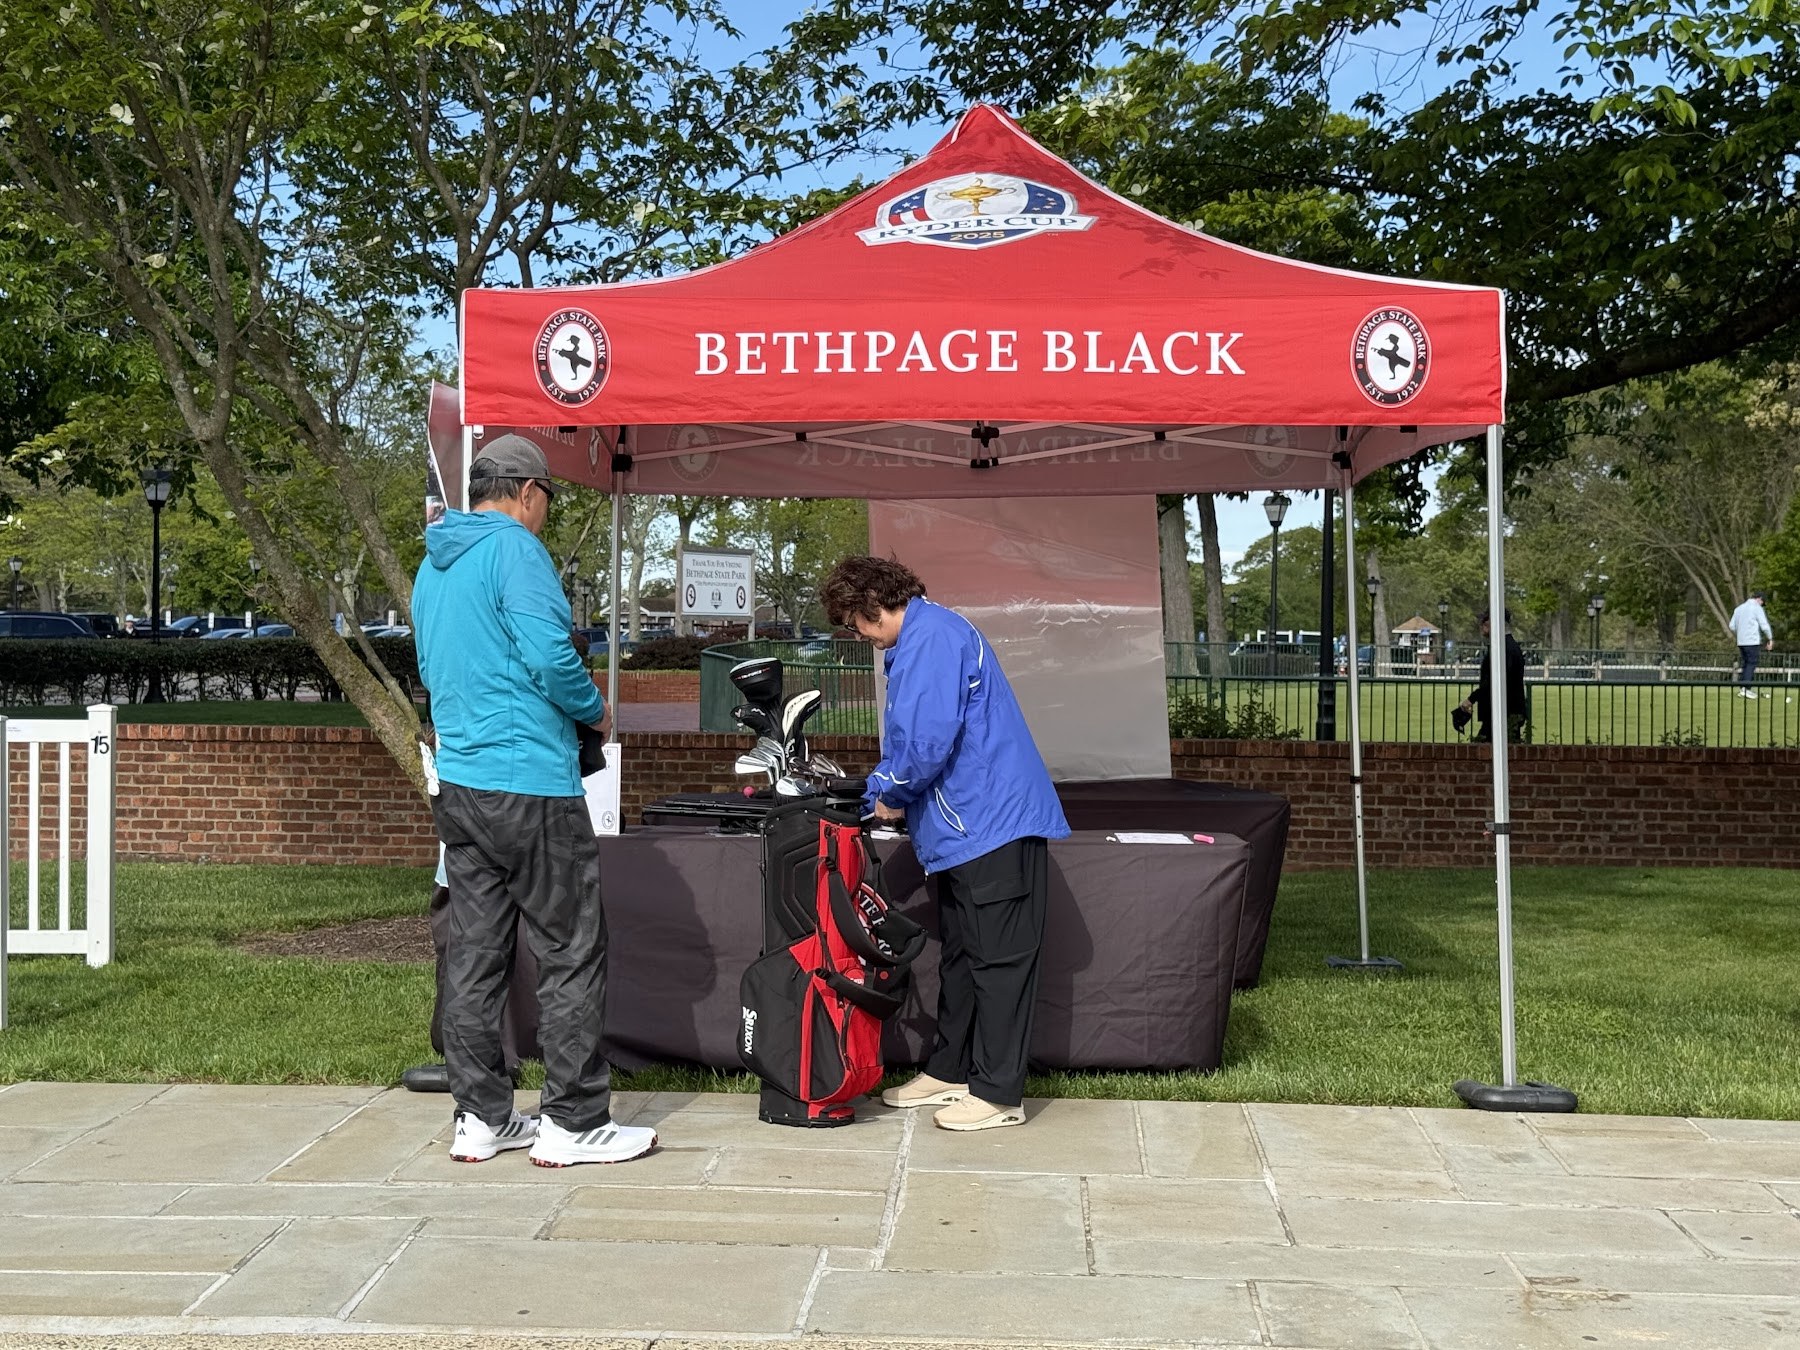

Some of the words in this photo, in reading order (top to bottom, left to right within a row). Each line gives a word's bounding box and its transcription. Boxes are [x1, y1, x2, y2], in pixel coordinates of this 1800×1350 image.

[879, 217, 1000, 238] RYDER
[1003, 216, 1078, 227] CUP
[950, 231, 1005, 241] 2025
[538, 313, 568, 361] BETHPAGE
[569, 312, 598, 333] STATE
[593, 332, 607, 360] PARK
[1355, 312, 1387, 359] BETHPAGE
[1389, 311, 1417, 333] STATE
[1413, 331, 1427, 360] PARK
[694, 329, 1019, 375] BETHPAGE
[1042, 330, 1246, 375] BLACK
[547, 382, 568, 402] EST.
[578, 381, 599, 401] 1932
[1364, 382, 1385, 402] EST.
[1397, 381, 1418, 401] 1932
[686, 568, 713, 579] BETHPAGE
[714, 570, 730, 579] STATE
[731, 570, 746, 580] PARK
[90, 735, 110, 754] 15
[743, 1006, 758, 1054] SRIXON
